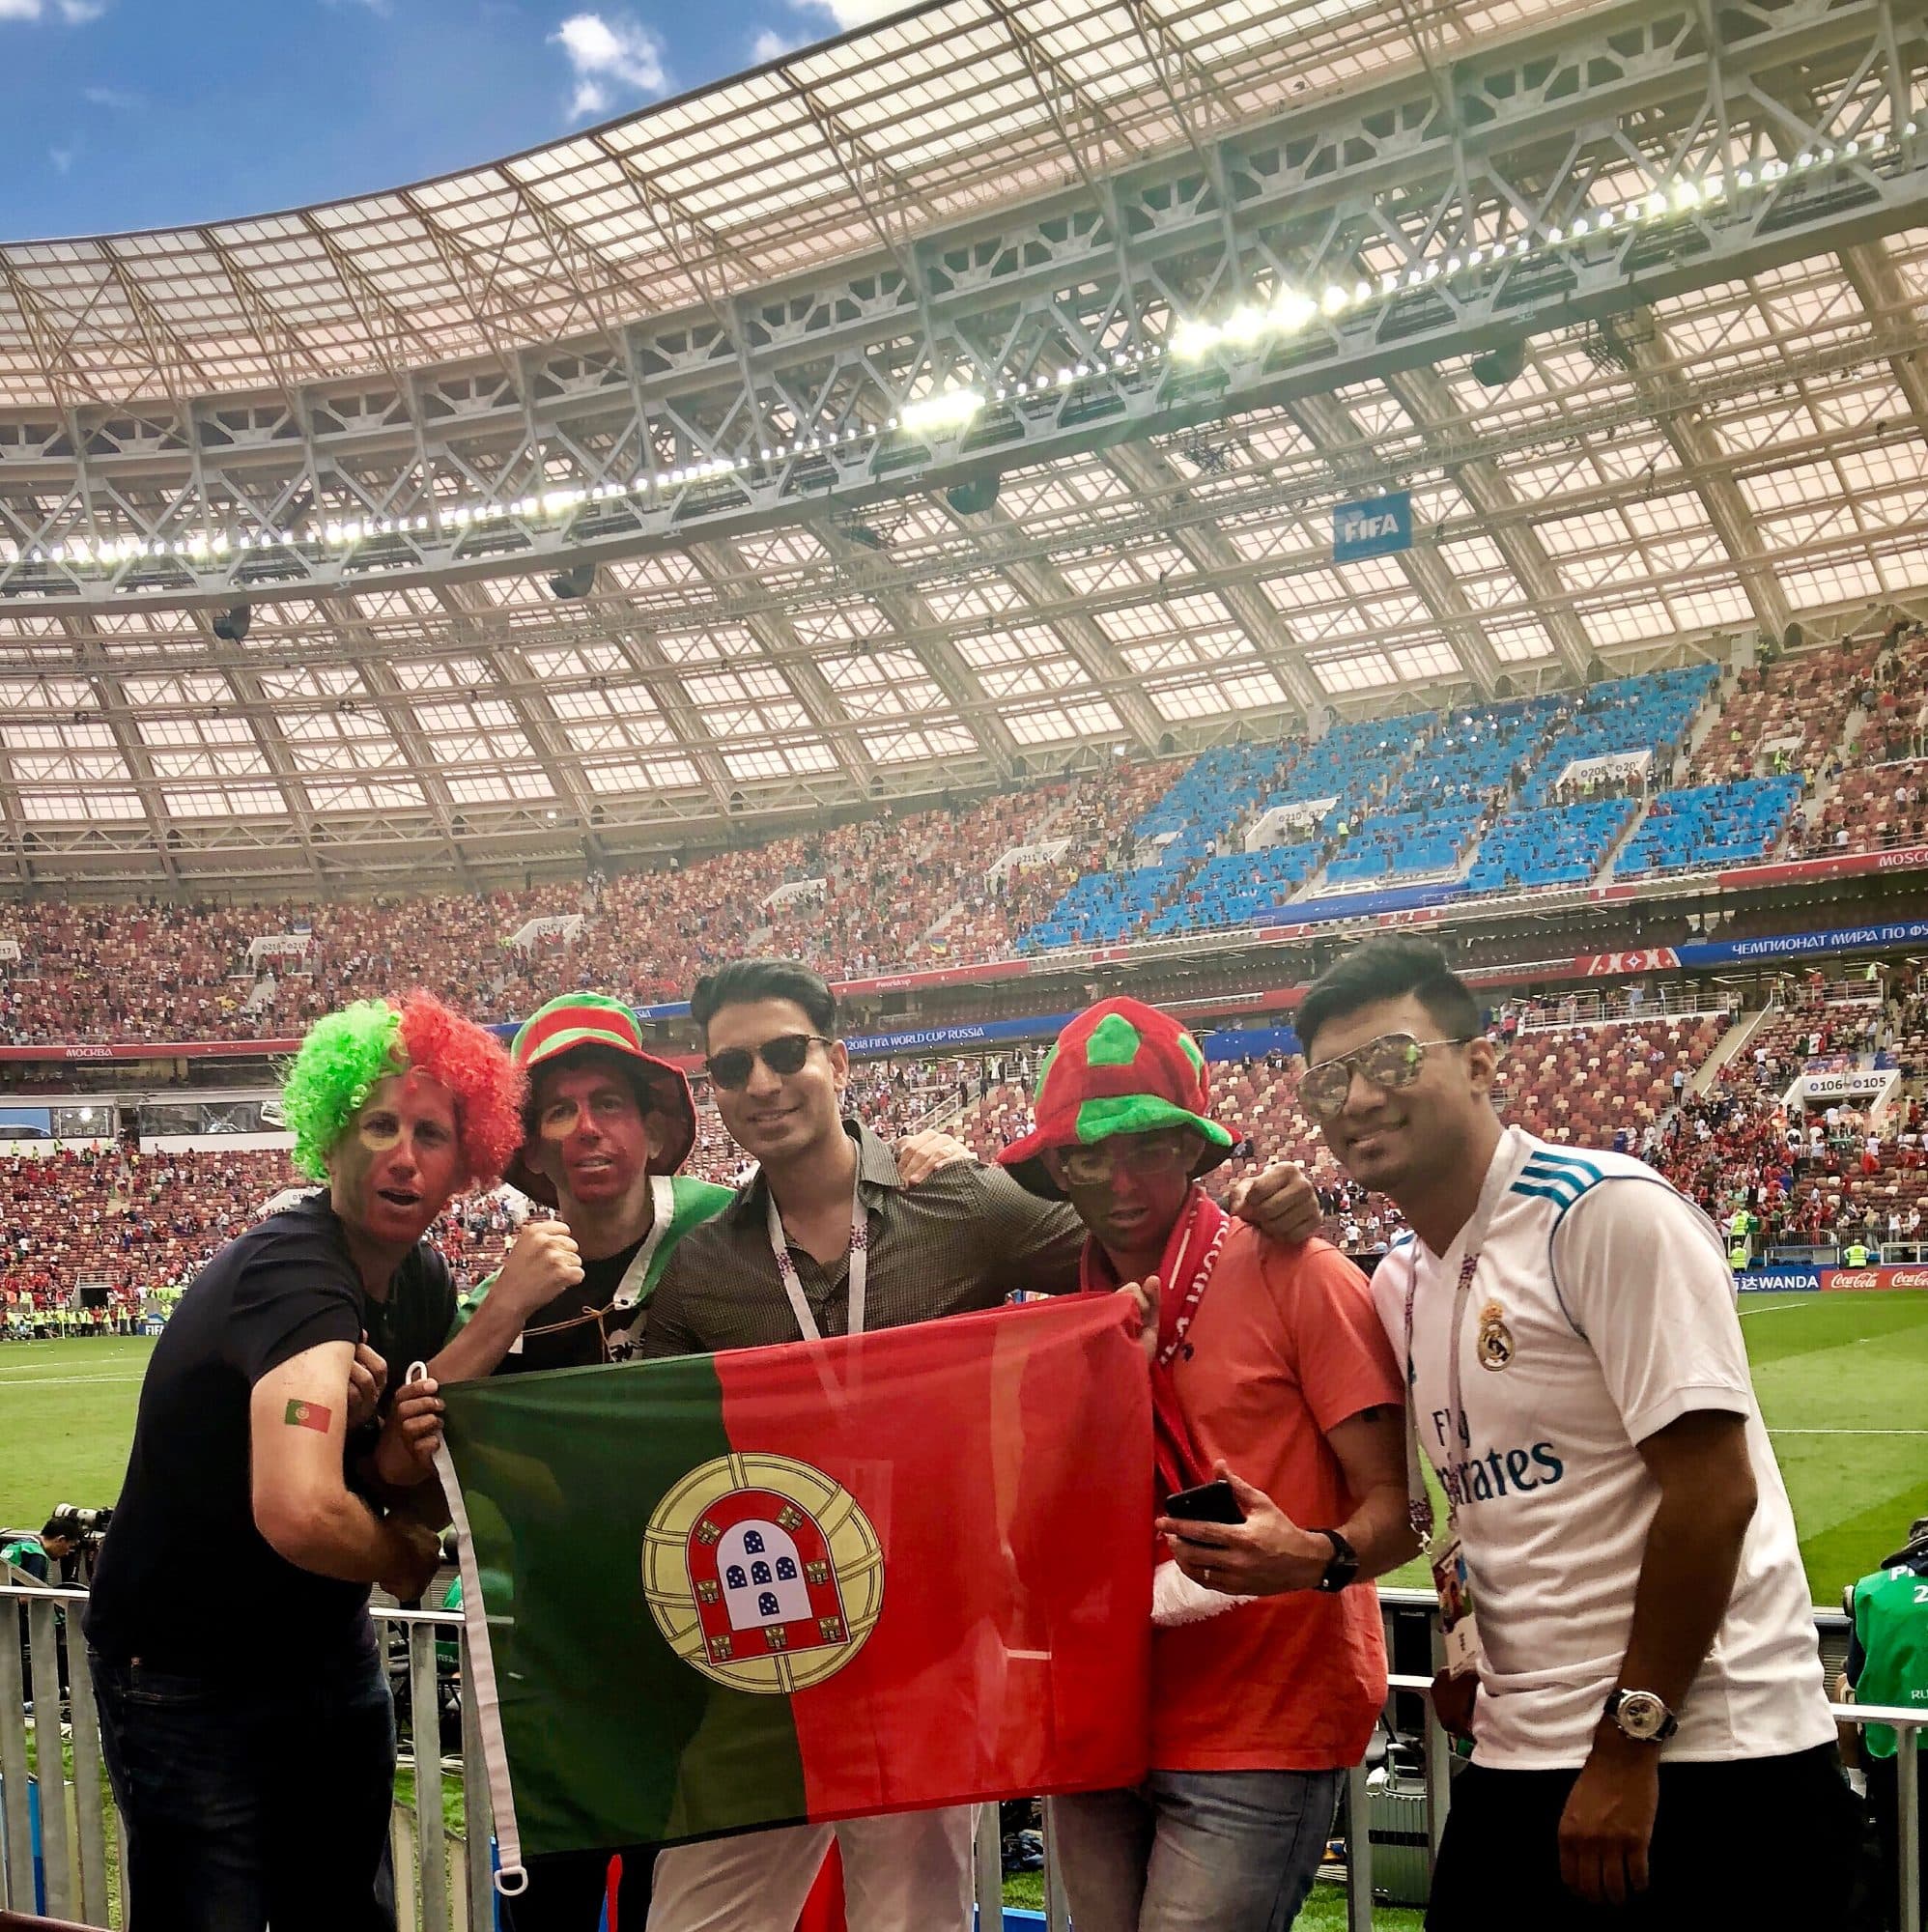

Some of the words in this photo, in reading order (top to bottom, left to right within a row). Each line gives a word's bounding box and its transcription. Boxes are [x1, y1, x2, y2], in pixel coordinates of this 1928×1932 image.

[1344, 513, 1400, 543] FIFA
[1732, 934, 1828, 955] ЧЕМПИОНАТ
[1830, 929, 1879, 946] МИРА
[1883, 926, 1906, 940] ПО
[847, 1040, 868, 1051] 2018
[869, 1037, 890, 1049] FIFA
[890, 1033, 924, 1046] WORLD
[925, 1030, 947, 1042] CUP
[948, 1026, 985, 1040] RUSSIA
[1758, 1275, 1820, 1290] WANDA
